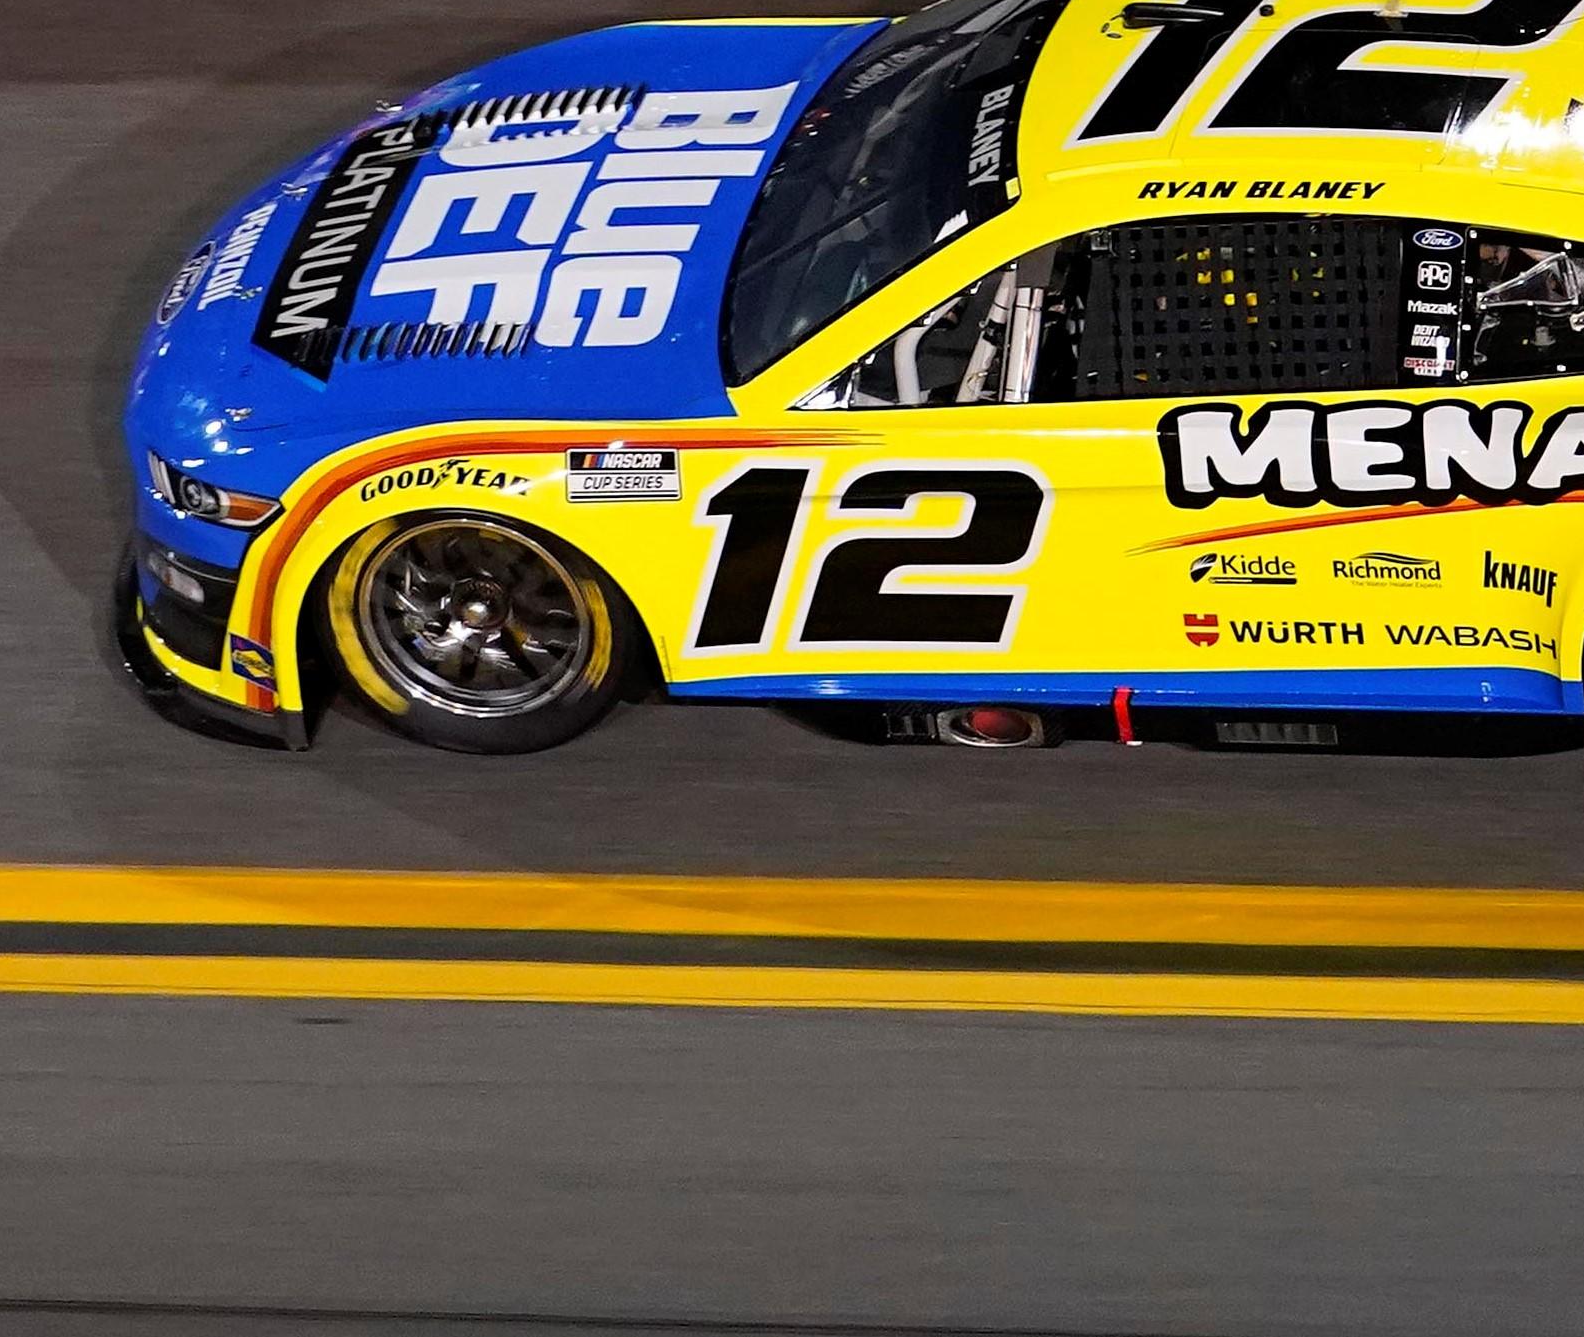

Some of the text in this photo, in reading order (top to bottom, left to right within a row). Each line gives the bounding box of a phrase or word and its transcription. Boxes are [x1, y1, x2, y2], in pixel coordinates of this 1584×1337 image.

[967, 83, 1015, 187] BLANEY
[1137, 180, 1387, 200] RYAN BLANEY
[369, 88, 629, 354] DEF
[533, 80, 800, 348] Blue
[269, 118, 418, 339] PLATINUM
[1420, 265, 1450, 287] PPG
[1406, 299, 1459, 316] Mazak
[1404, 357, 1456, 371] DISCOUT
[601, 453, 663, 469] NASCAR
[583, 475, 664, 490] CUP SERIES
[686, 461, 1050, 653] 12
[1220, 554, 1296, 576] Kidde
[1332, 559, 1442, 581] Richmond
[1230, 620, 1365, 646] WÜRTH
[1384, 624, 1558, 660] WABASH
